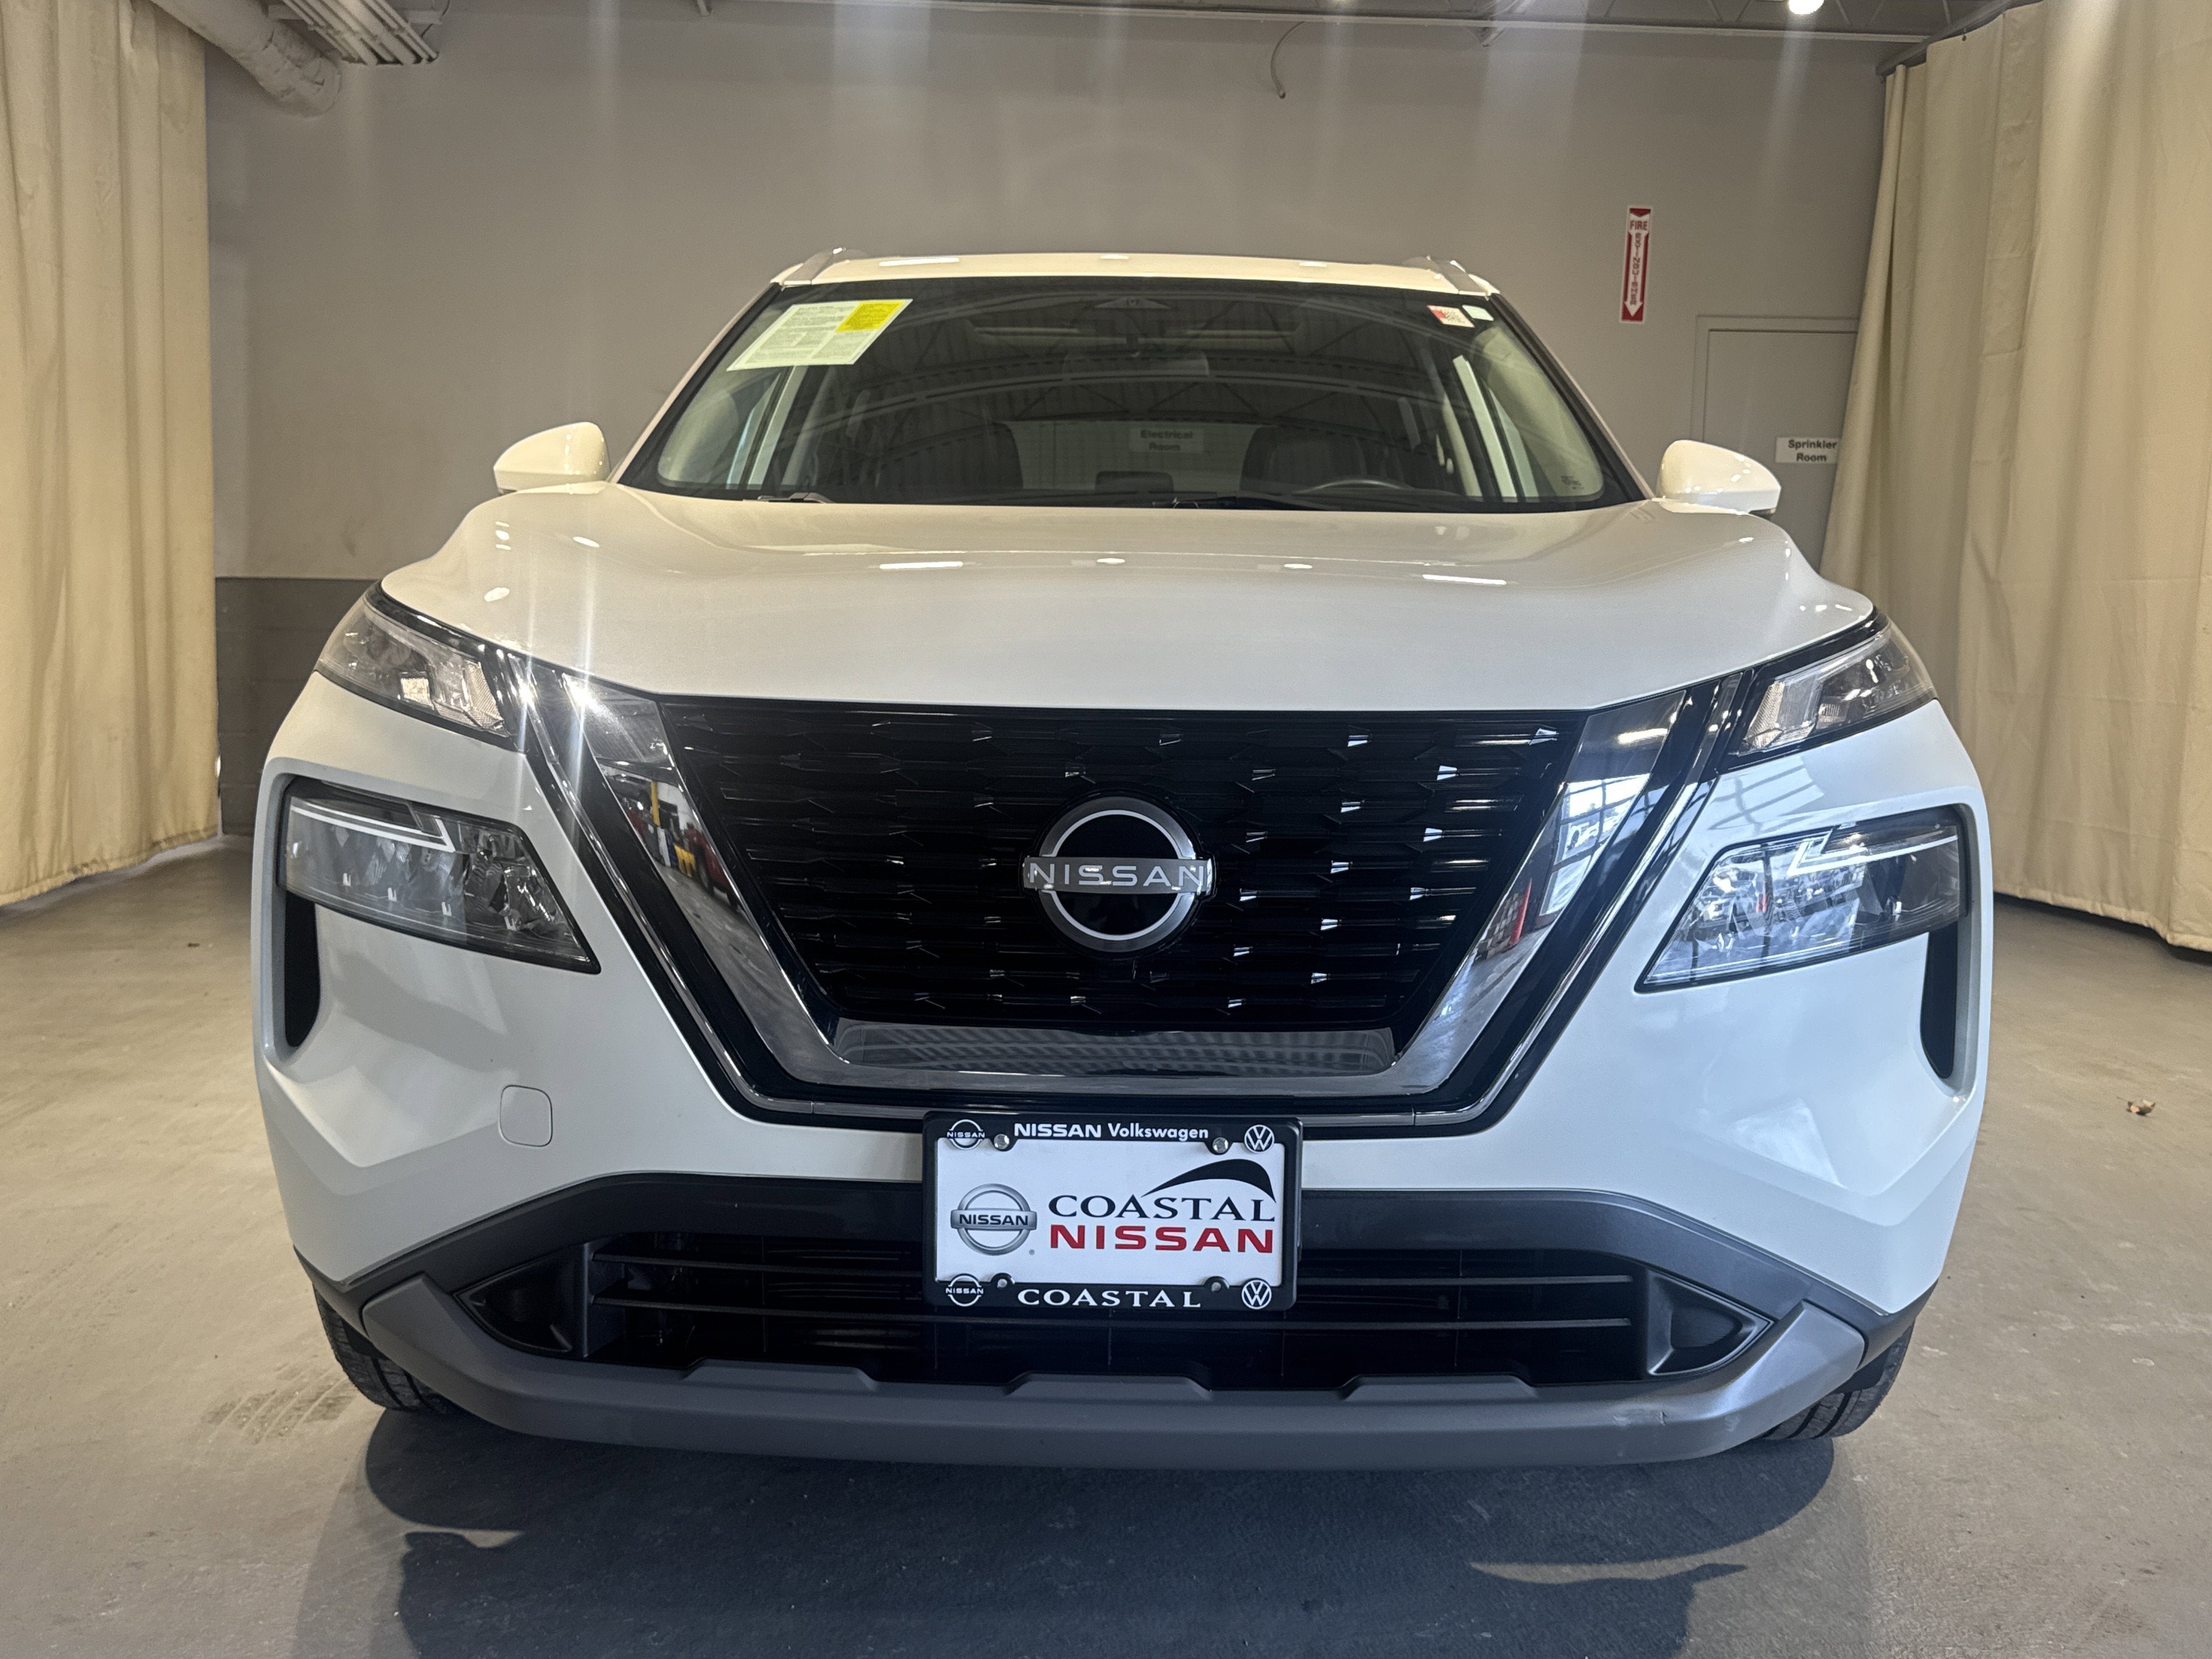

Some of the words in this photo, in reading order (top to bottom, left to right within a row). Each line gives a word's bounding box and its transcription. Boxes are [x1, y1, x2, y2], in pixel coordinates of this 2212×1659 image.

[1630, 221, 1647, 230] FIRE
[1630, 232, 1641, 306] EXTINGUISHER
[1788, 439, 1837, 450] Sprinkler
[1796, 453, 1827, 462] Room
[1029, 862, 1205, 888] NISSAN
[1014, 1124, 1102, 1138] NISSAN
[1107, 1123, 1209, 1142] Volkswagen
[1048, 1194, 1275, 1222] COASTAL
[960, 1214, 1029, 1226] NISSAN
[1050, 1224, 1273, 1254] NISSAN
[1017, 1288, 1201, 1308] COASTAL
